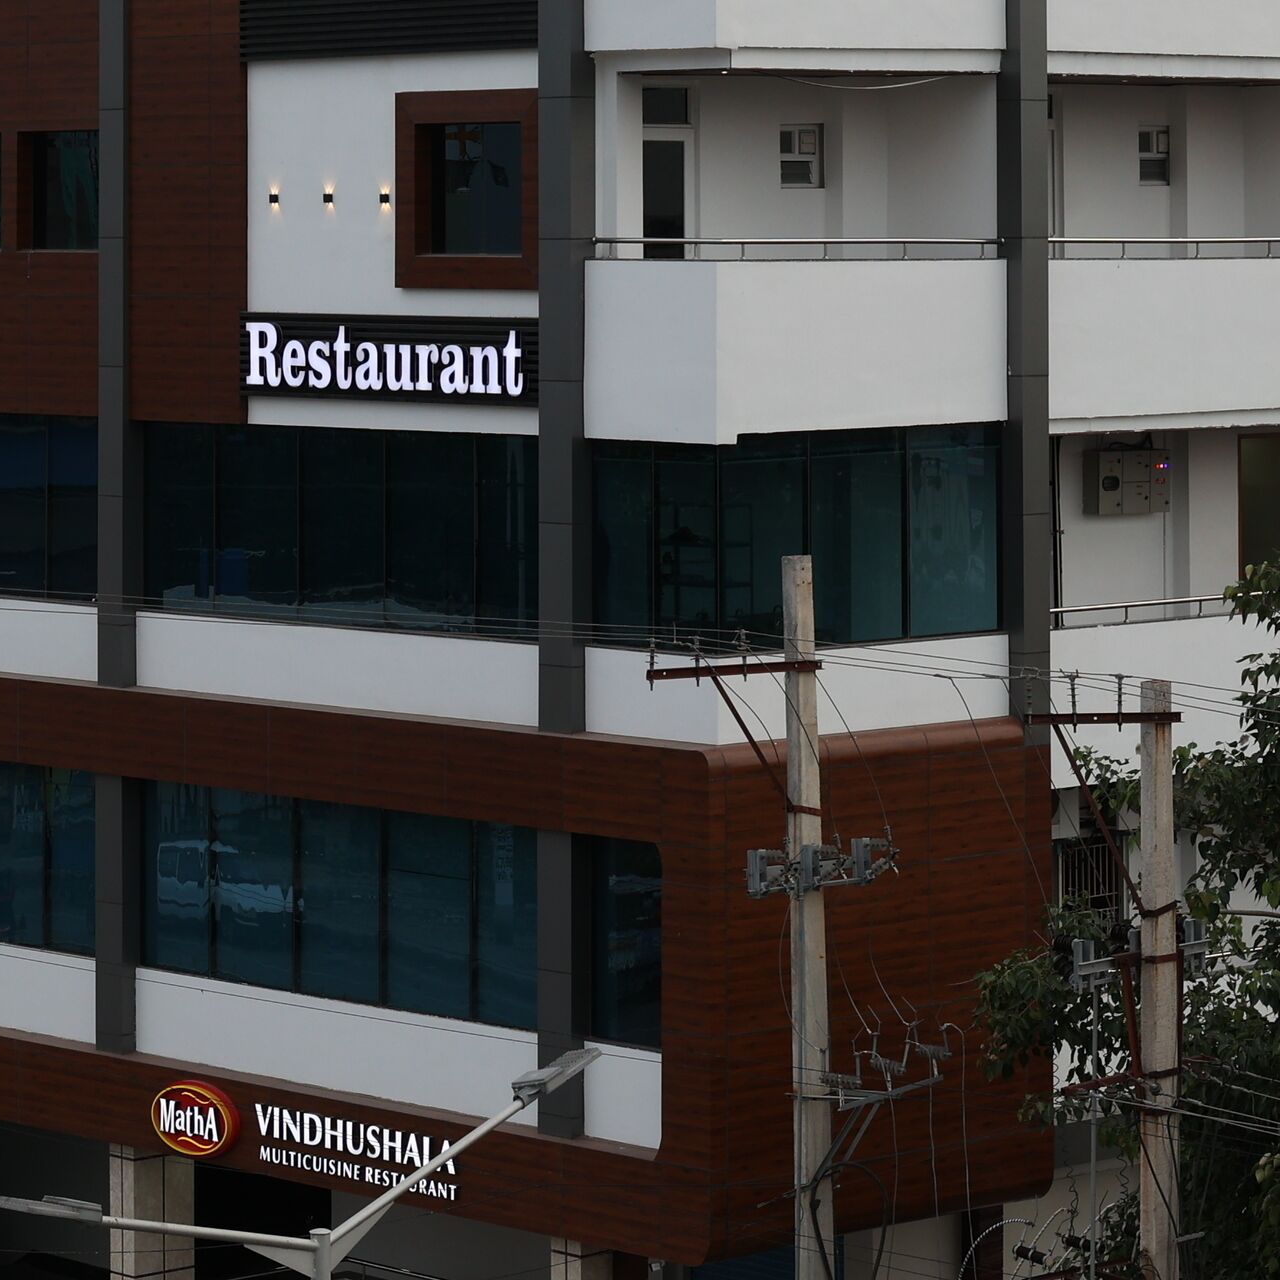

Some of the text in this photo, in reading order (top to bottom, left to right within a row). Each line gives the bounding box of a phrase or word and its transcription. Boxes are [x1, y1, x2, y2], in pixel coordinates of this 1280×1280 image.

[245, 321, 524, 397] Restaurant
[158, 1097, 219, 1144] MathA
[259, 1145, 360, 1181] MULTICUISINE
